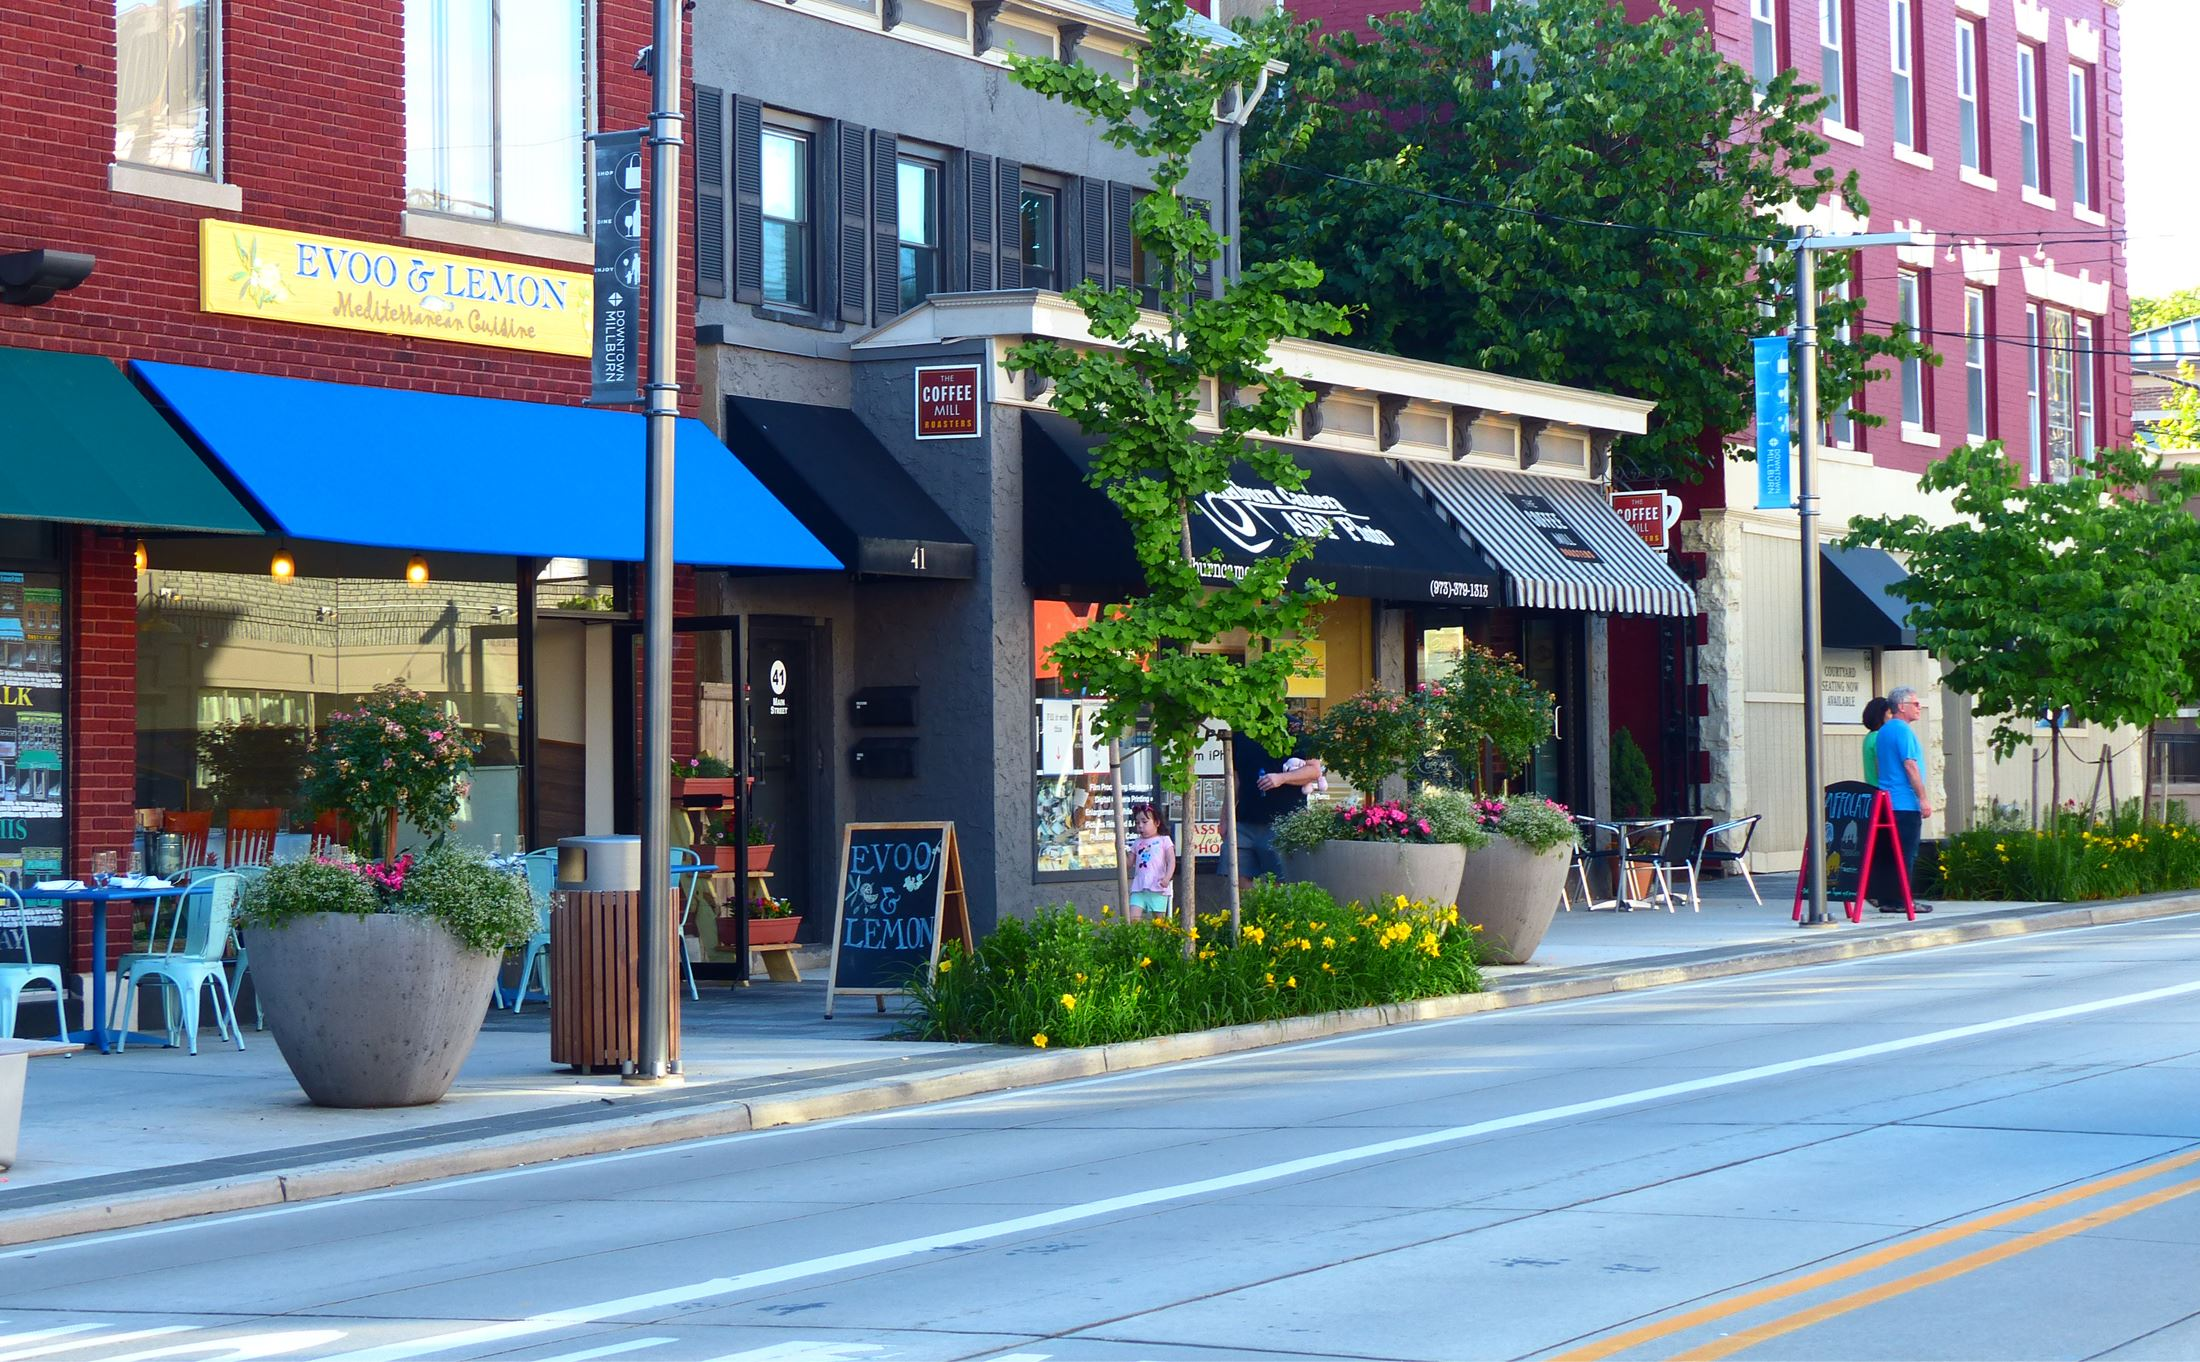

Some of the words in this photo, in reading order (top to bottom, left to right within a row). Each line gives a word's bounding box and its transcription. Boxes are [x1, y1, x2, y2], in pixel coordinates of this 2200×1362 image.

[296, 243, 398, 288] EVOO
[407, 260, 435, 293] &
[444, 264, 568, 310] LEMON
[333, 291, 464, 332] Mediterranean
[468, 309, 537, 339] Cuisine
[605, 310, 616, 382] MILLBURN
[616, 310, 626, 382] DOWNTOWN
[922, 385, 972, 402] COFFEE
[924, 419, 972, 429] ROASTERS
[934, 404, 960, 416] MILL
[1334, 516, 1395, 546] Photo
[1524, 510, 1568, 530] COFFEE
[910, 547, 927, 570] 41
[1430, 580, 1489, 599] (973)-379-1313
[772, 669, 785, 686] 41
[851, 841, 931, 875] EVOO
[880, 887, 900, 915] &
[843, 916, 935, 950] LEMON
